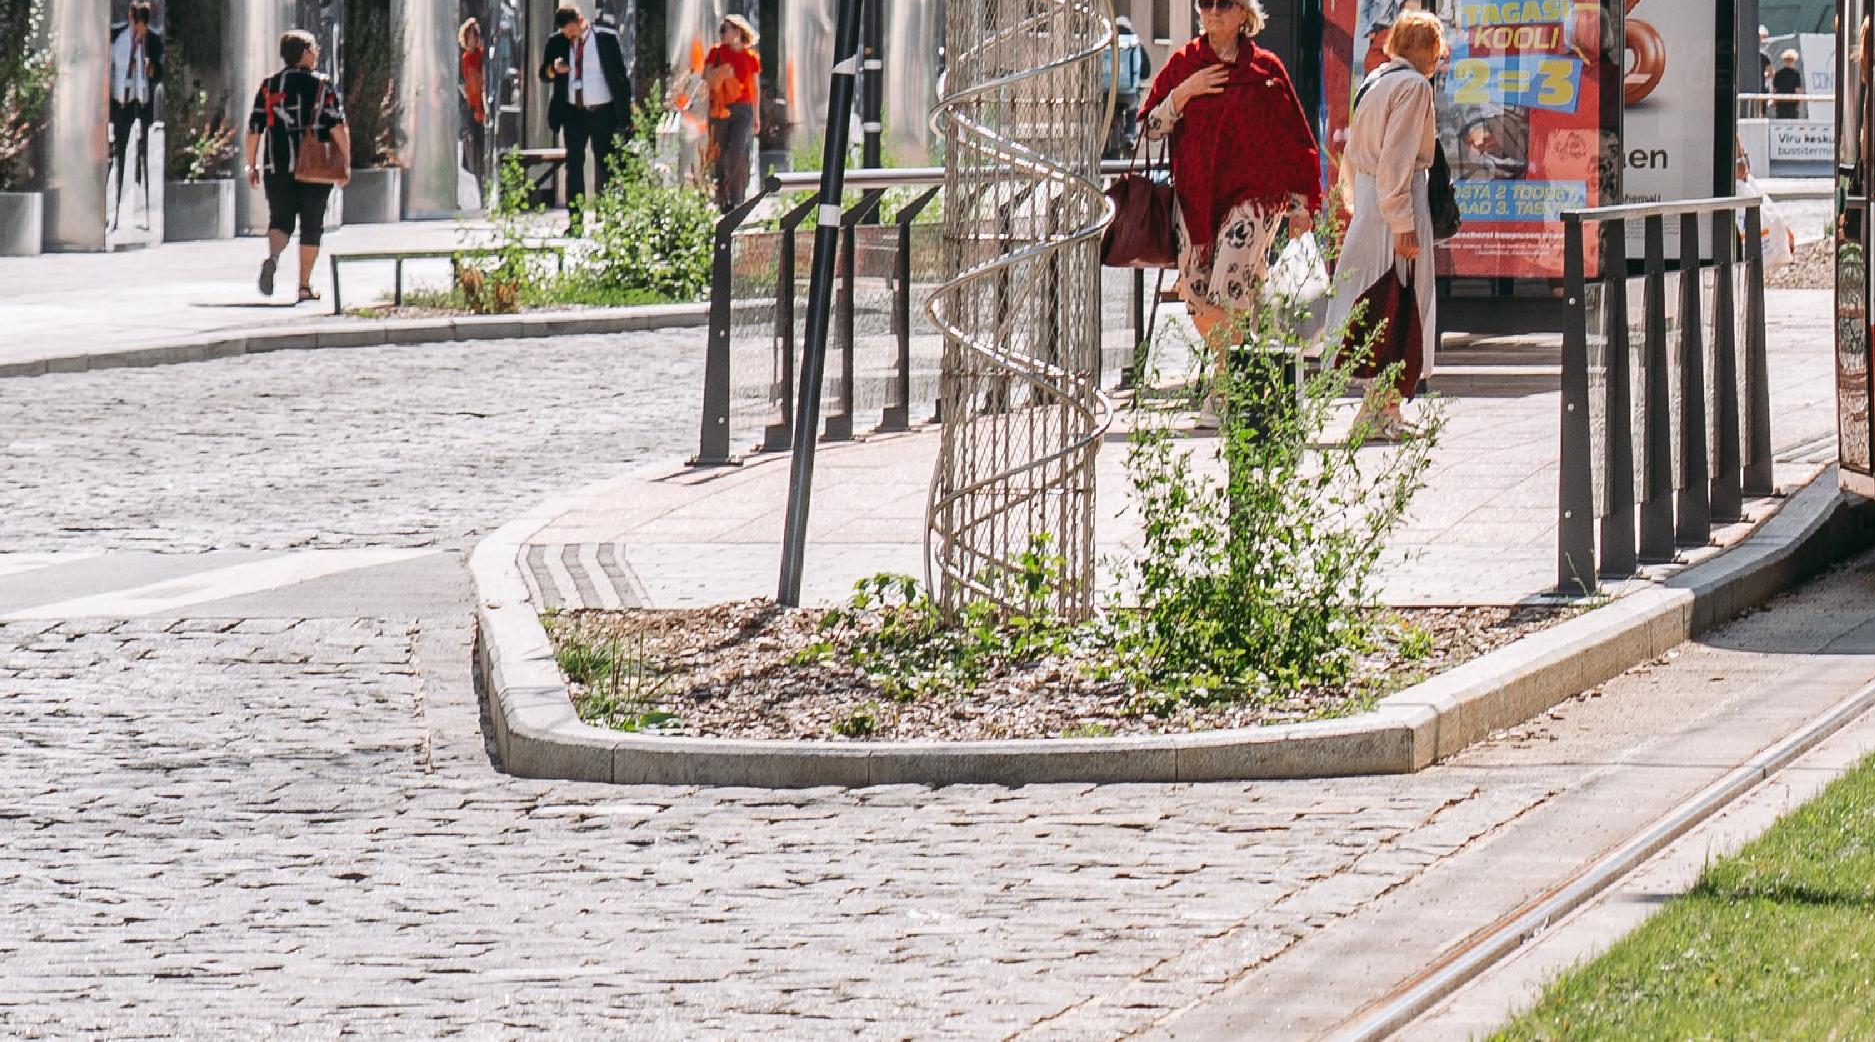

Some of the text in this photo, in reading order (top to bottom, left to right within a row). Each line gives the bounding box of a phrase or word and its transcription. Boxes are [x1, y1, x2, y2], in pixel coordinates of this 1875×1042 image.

[1463, 0, 1571, 26] TAGASI
[1473, 26, 1560, 50] KOOLI
[1778, 133, 1801, 144] Viru
